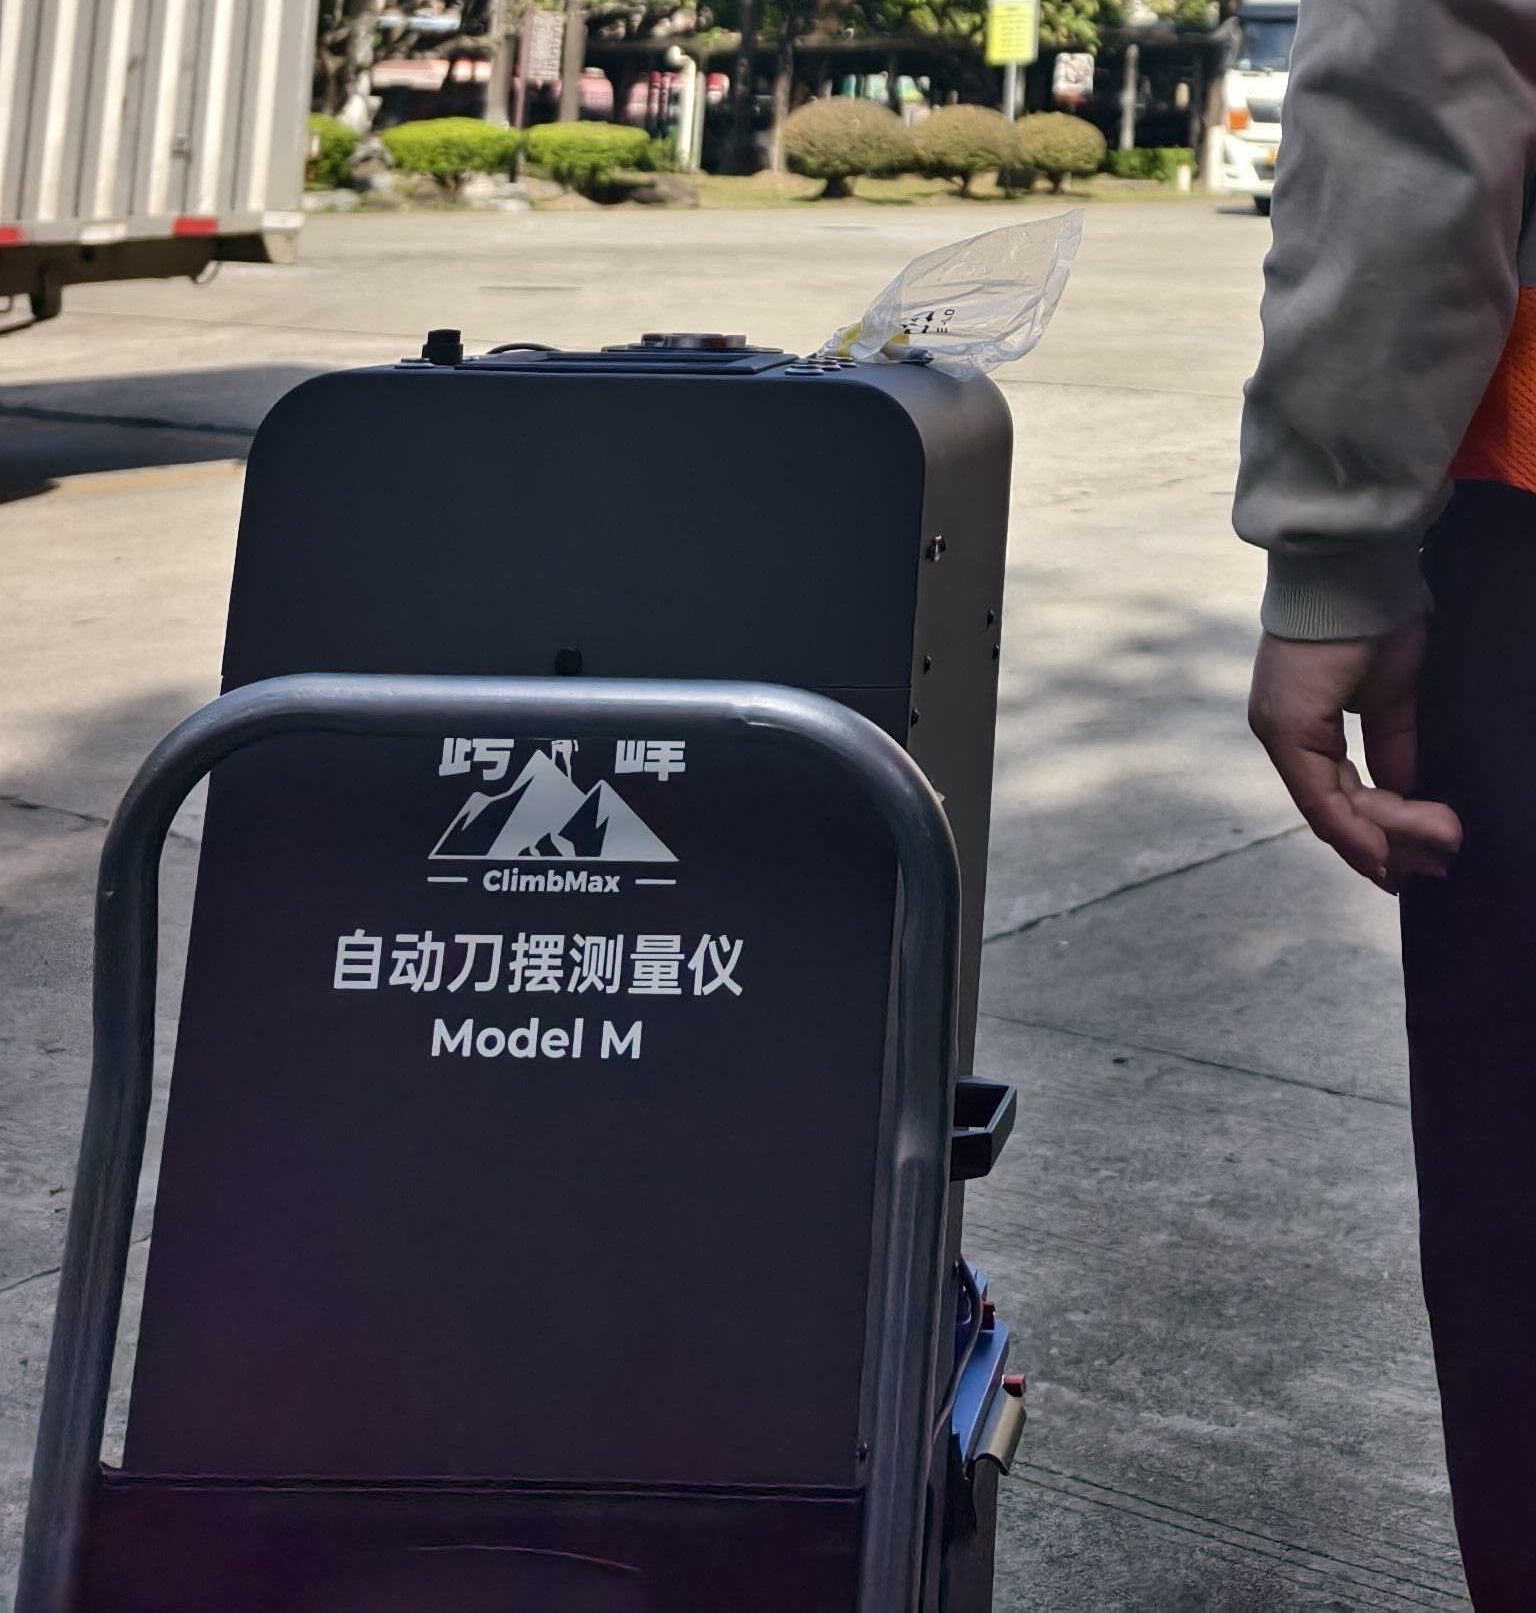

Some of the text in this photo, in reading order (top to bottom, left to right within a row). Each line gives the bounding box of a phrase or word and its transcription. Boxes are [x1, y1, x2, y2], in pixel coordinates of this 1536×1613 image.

[482, 868, 621, 893] ClimbMax
[333, 928, 744, 997] 自动刀摆测量仪
[431, 1017, 643, 1060] Model M
